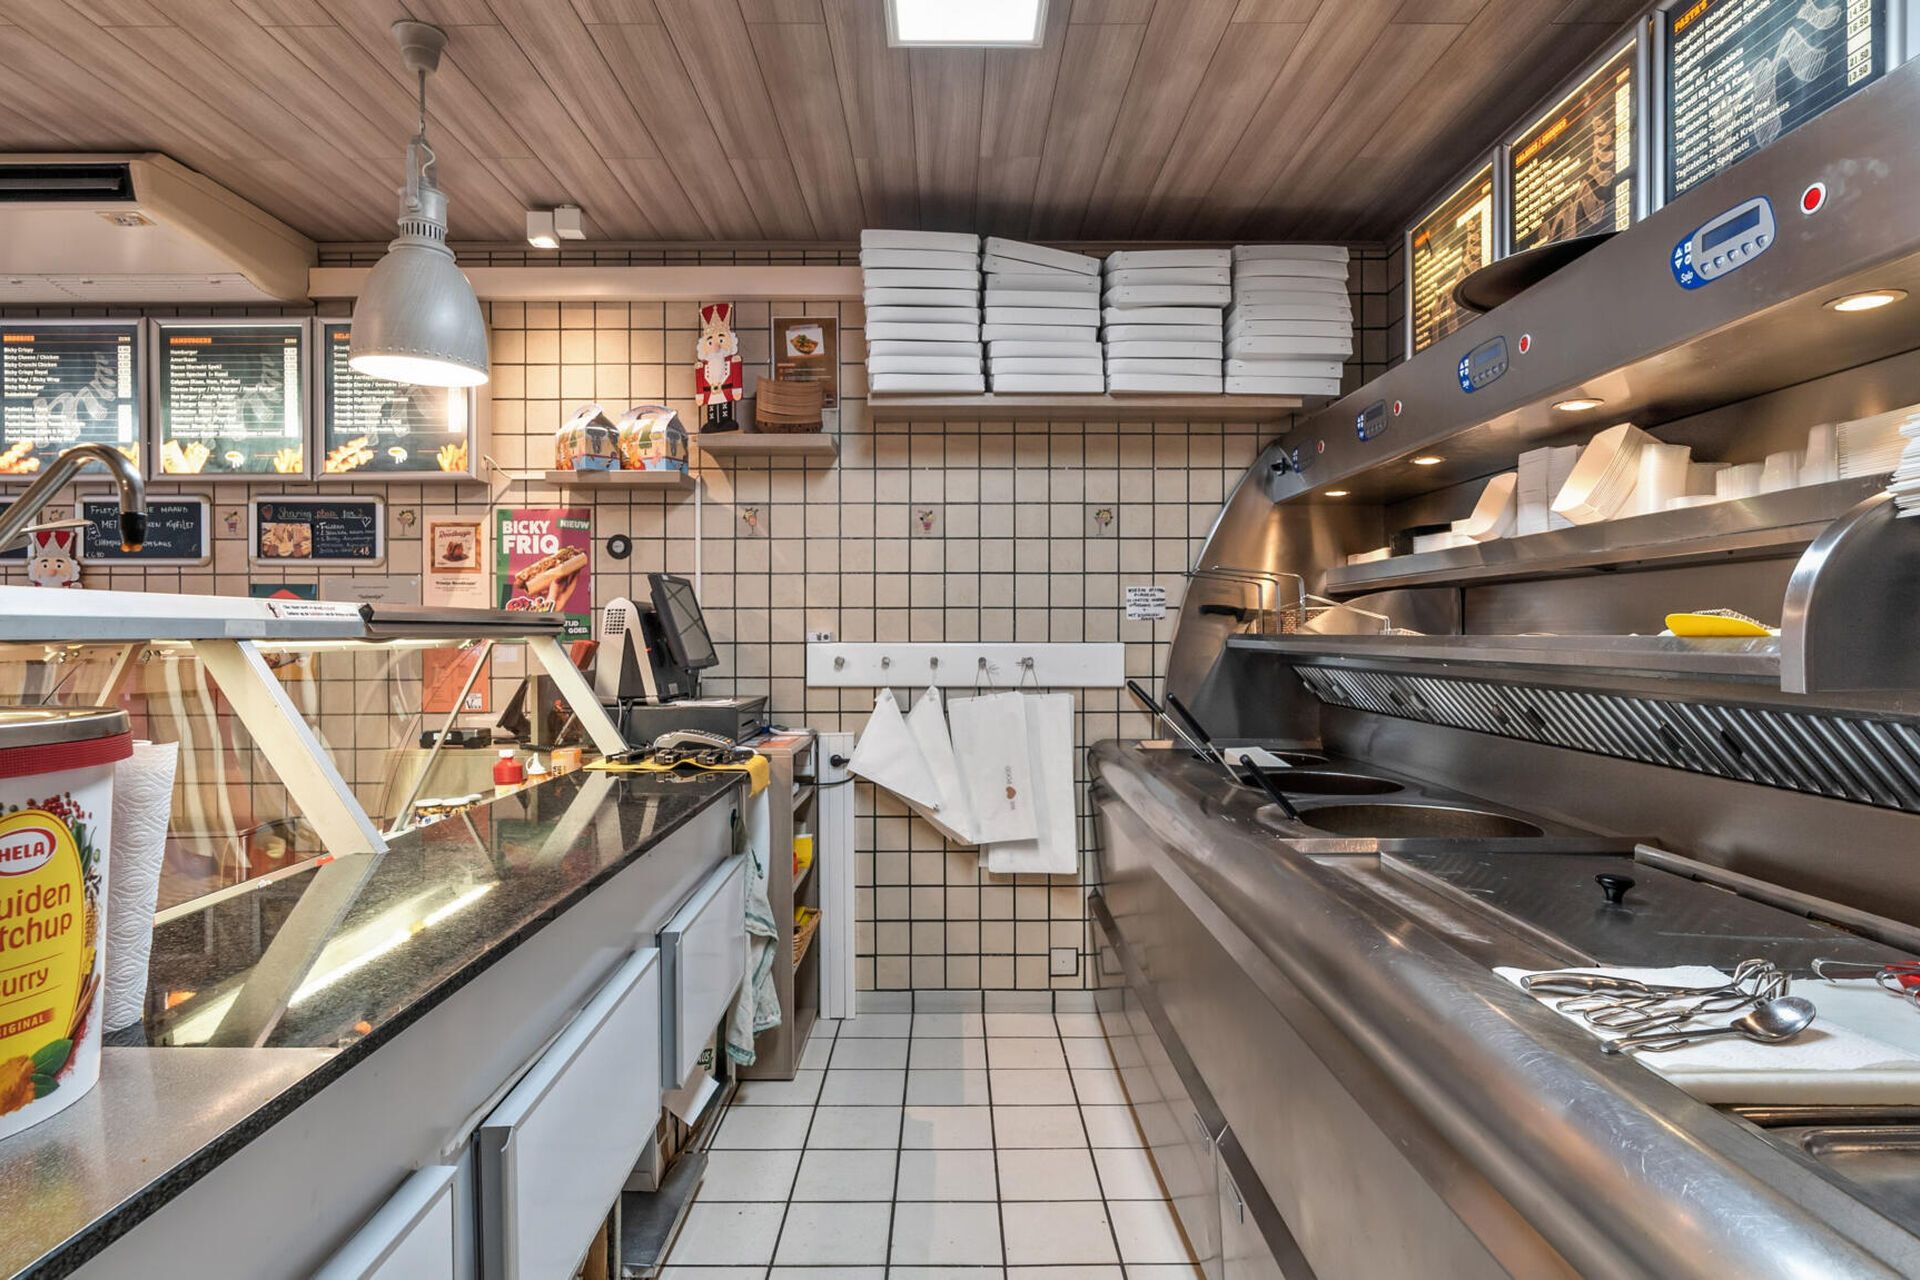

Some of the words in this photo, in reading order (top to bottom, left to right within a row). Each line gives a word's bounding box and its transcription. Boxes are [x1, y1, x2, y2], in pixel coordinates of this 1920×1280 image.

[1674, 20, 1704, 52] Spaghetti
[1674, 34, 1704, 65] Spaghetti
[1850, 51, 1869, 68] 21.50
[1674, 48, 1704, 78] Spaghetti
[1717, 139, 1750, 167] Spaghetti
[502, 520, 550, 534] BICKY
[559, 519, 590, 529] NIEUW
[503, 534, 560, 554] FRIQ
[0, 842, 45, 862] HELA
[0, 967, 48, 997] urry
[0, 1014, 45, 1037] IGINAL
